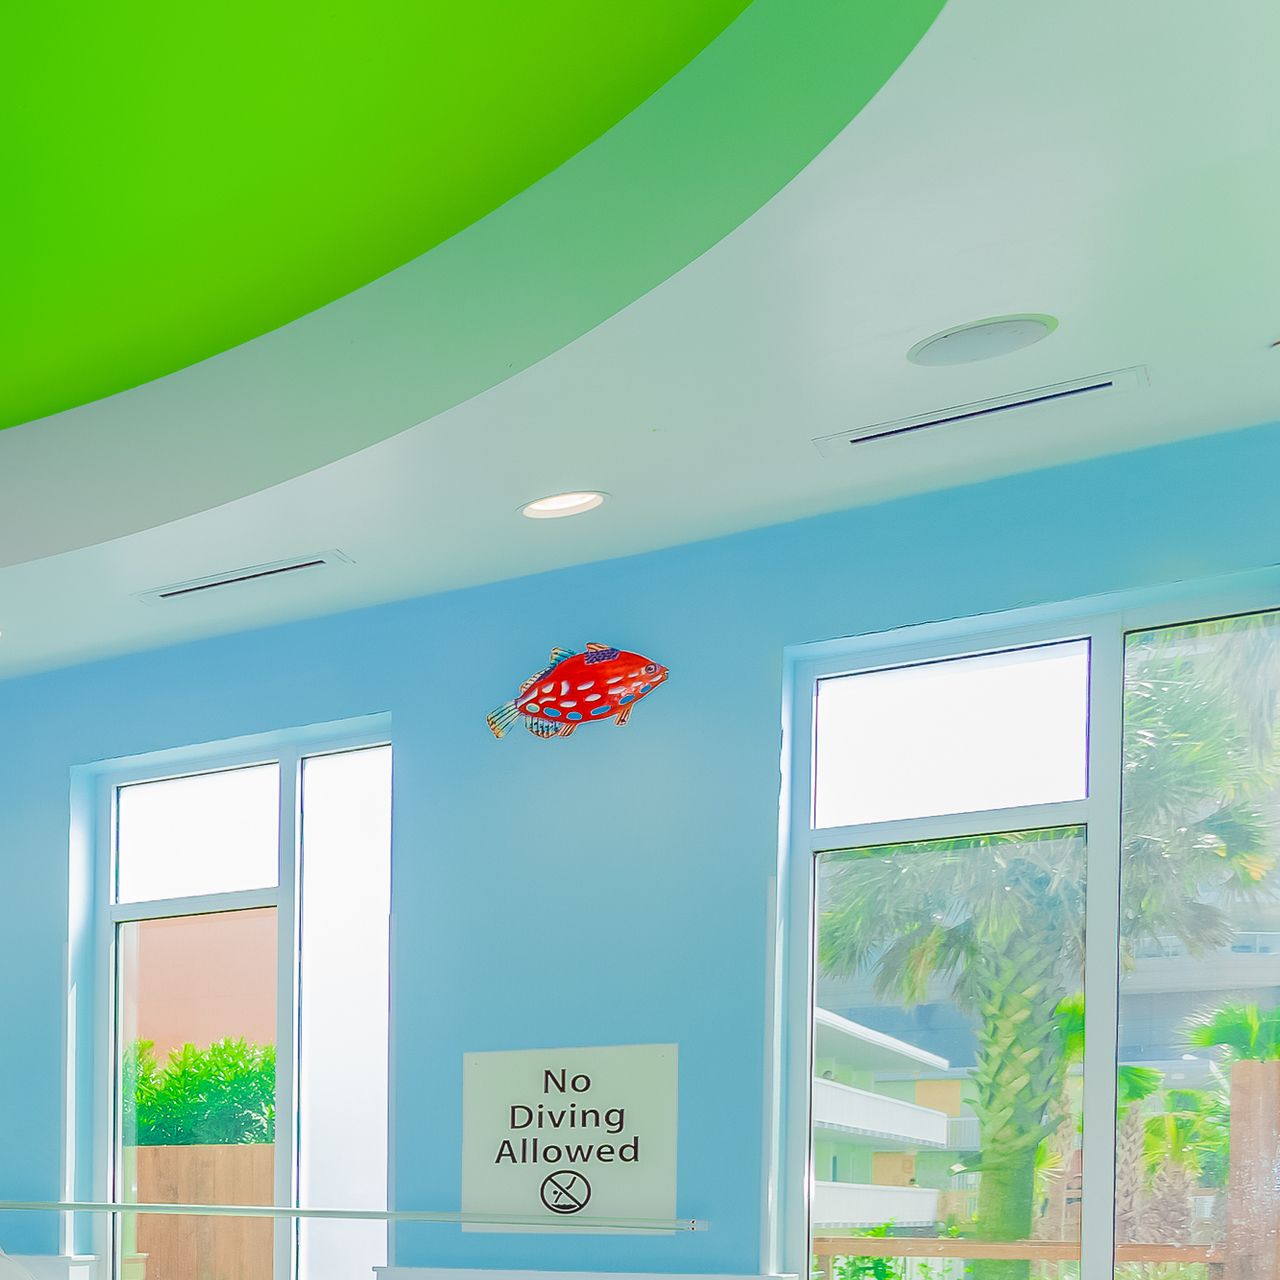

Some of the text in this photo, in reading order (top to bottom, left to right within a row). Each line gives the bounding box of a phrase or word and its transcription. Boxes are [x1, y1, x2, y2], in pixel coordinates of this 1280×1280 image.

[543, 1068, 591, 1093] No
[510, 1102, 625, 1134] Diving
[494, 1135, 639, 1164] Allowed
